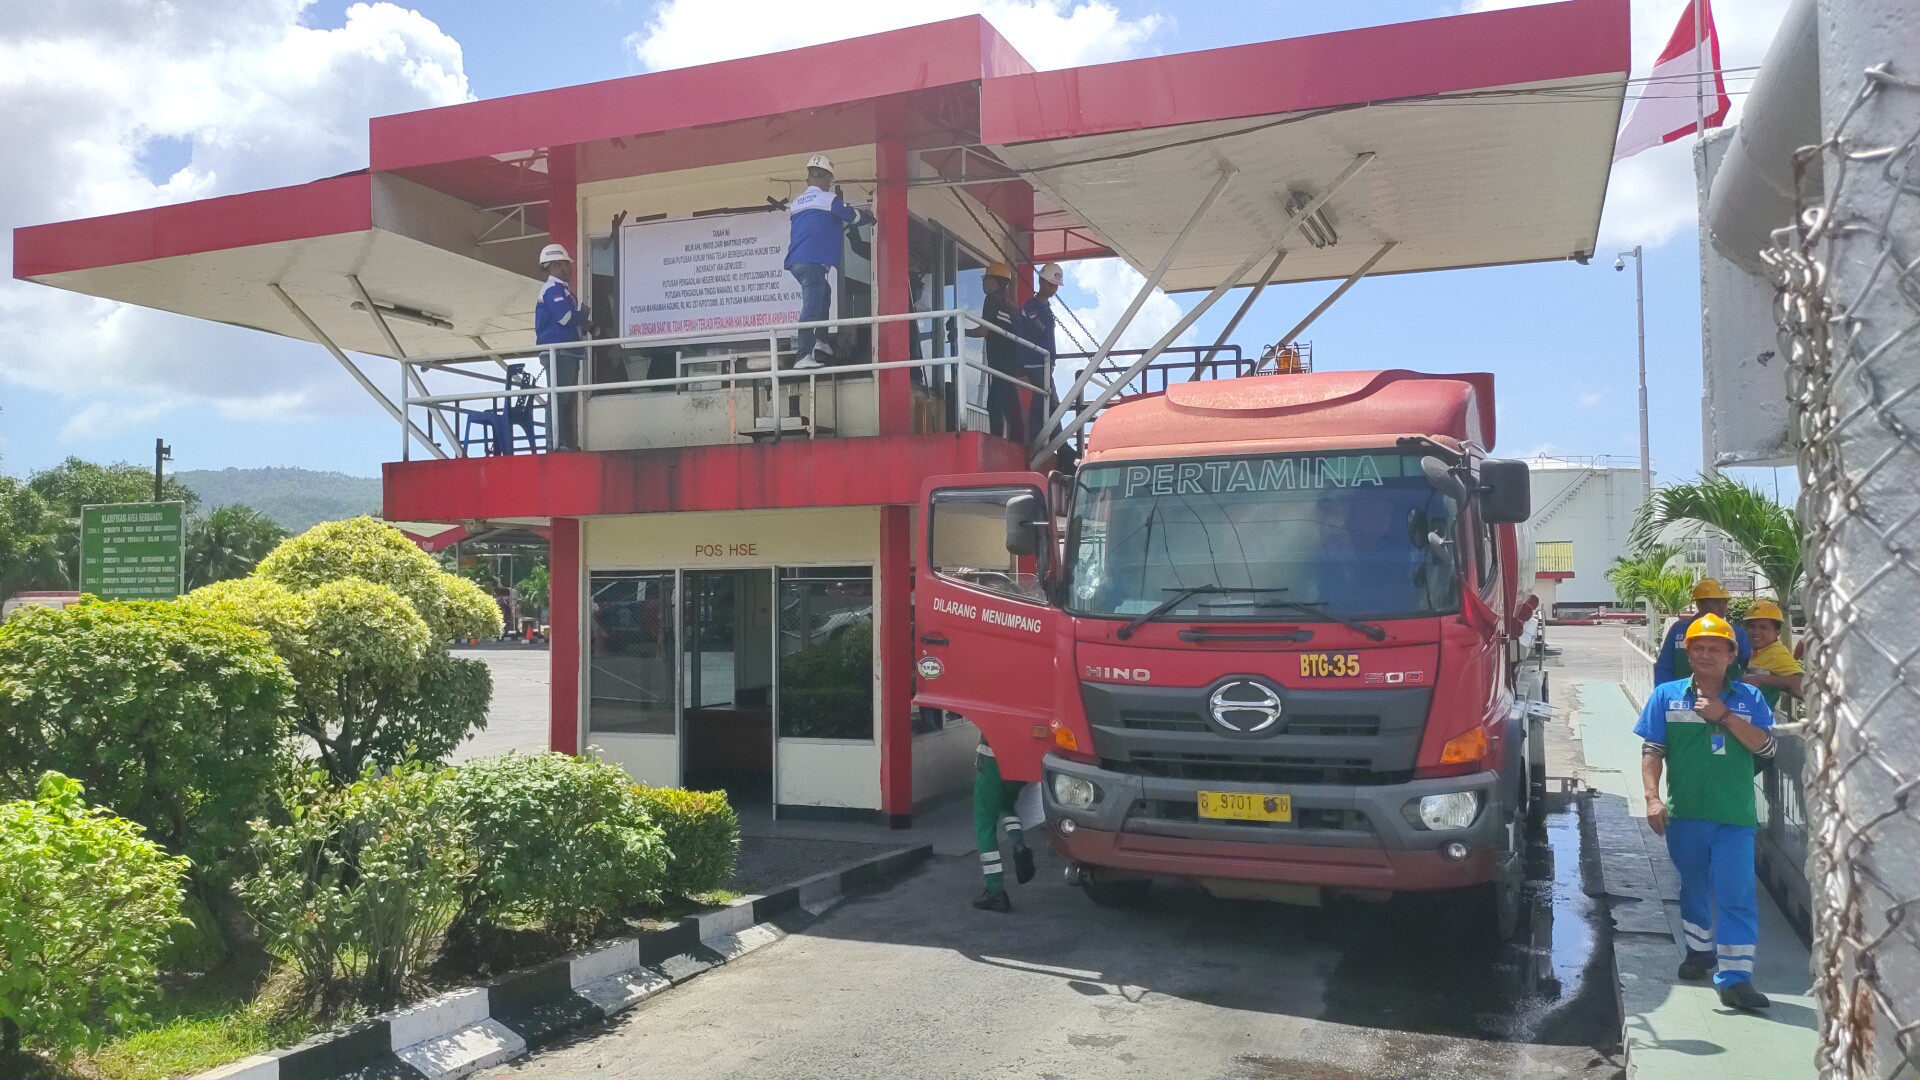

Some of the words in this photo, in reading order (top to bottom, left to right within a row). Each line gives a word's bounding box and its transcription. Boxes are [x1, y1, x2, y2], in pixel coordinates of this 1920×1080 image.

[712, 229, 724, 238] TANAH
[685, 244, 694, 252] MILIK
[703, 241, 714, 250] WARIS
[714, 240, 723, 249] DARI
[724, 239, 742, 248] MARTINUS
[742, 237, 757, 245] PONTOH
[663, 257, 675, 265] SESUAI
[676, 256, 692, 264] PUTUSAN
[693, 254, 705, 262] HUKUM
[706, 253, 715, 261] YANG
[715, 251, 727, 260] TELAH
[727, 249, 754, 258] BERKEKUATAN
[755, 247, 768, 256] HUKUM
[769, 246, 781, 254] TETAP
[662, 280, 678, 288] PUTUSAN
[679, 278, 701, 287] PENGADILAN
[701, 276, 715, 284] NEGERI
[665, 291, 680, 299] PUTUSAN
[682, 288, 703, 298] PENGADILAN
[704, 287, 716, 295] TINGGI
[630, 305, 646, 314] PUTUSAN
[647, 303, 666, 312] MAHKAMAH
[725, 296, 742, 305] PUTUSAN
[642, 322, 656, 335] DENGAN
[656, 321, 666, 334] SAAT
[672, 320, 683, 332] TIDAK
[683, 319, 698, 331] PERNAH
[698, 318, 713, 330] TERJADI
[714, 315, 734, 329] PERALIHAN
[743, 314, 756, 326] DALAM
[756, 312, 771, 326] BENTUK
[1124, 455, 1384, 498] PERTAMINA
[695, 544, 722, 557] POS
[933, 598, 976, 619] DILARANG
[981, 608, 1042, 633] MENUMPANG
[1300, 654, 1360, 677] BTG-35
[1086, 666, 1151, 681] HINO
[1364, 671, 1424, 684] 500
[1221, 794, 1252, 810] 9701
